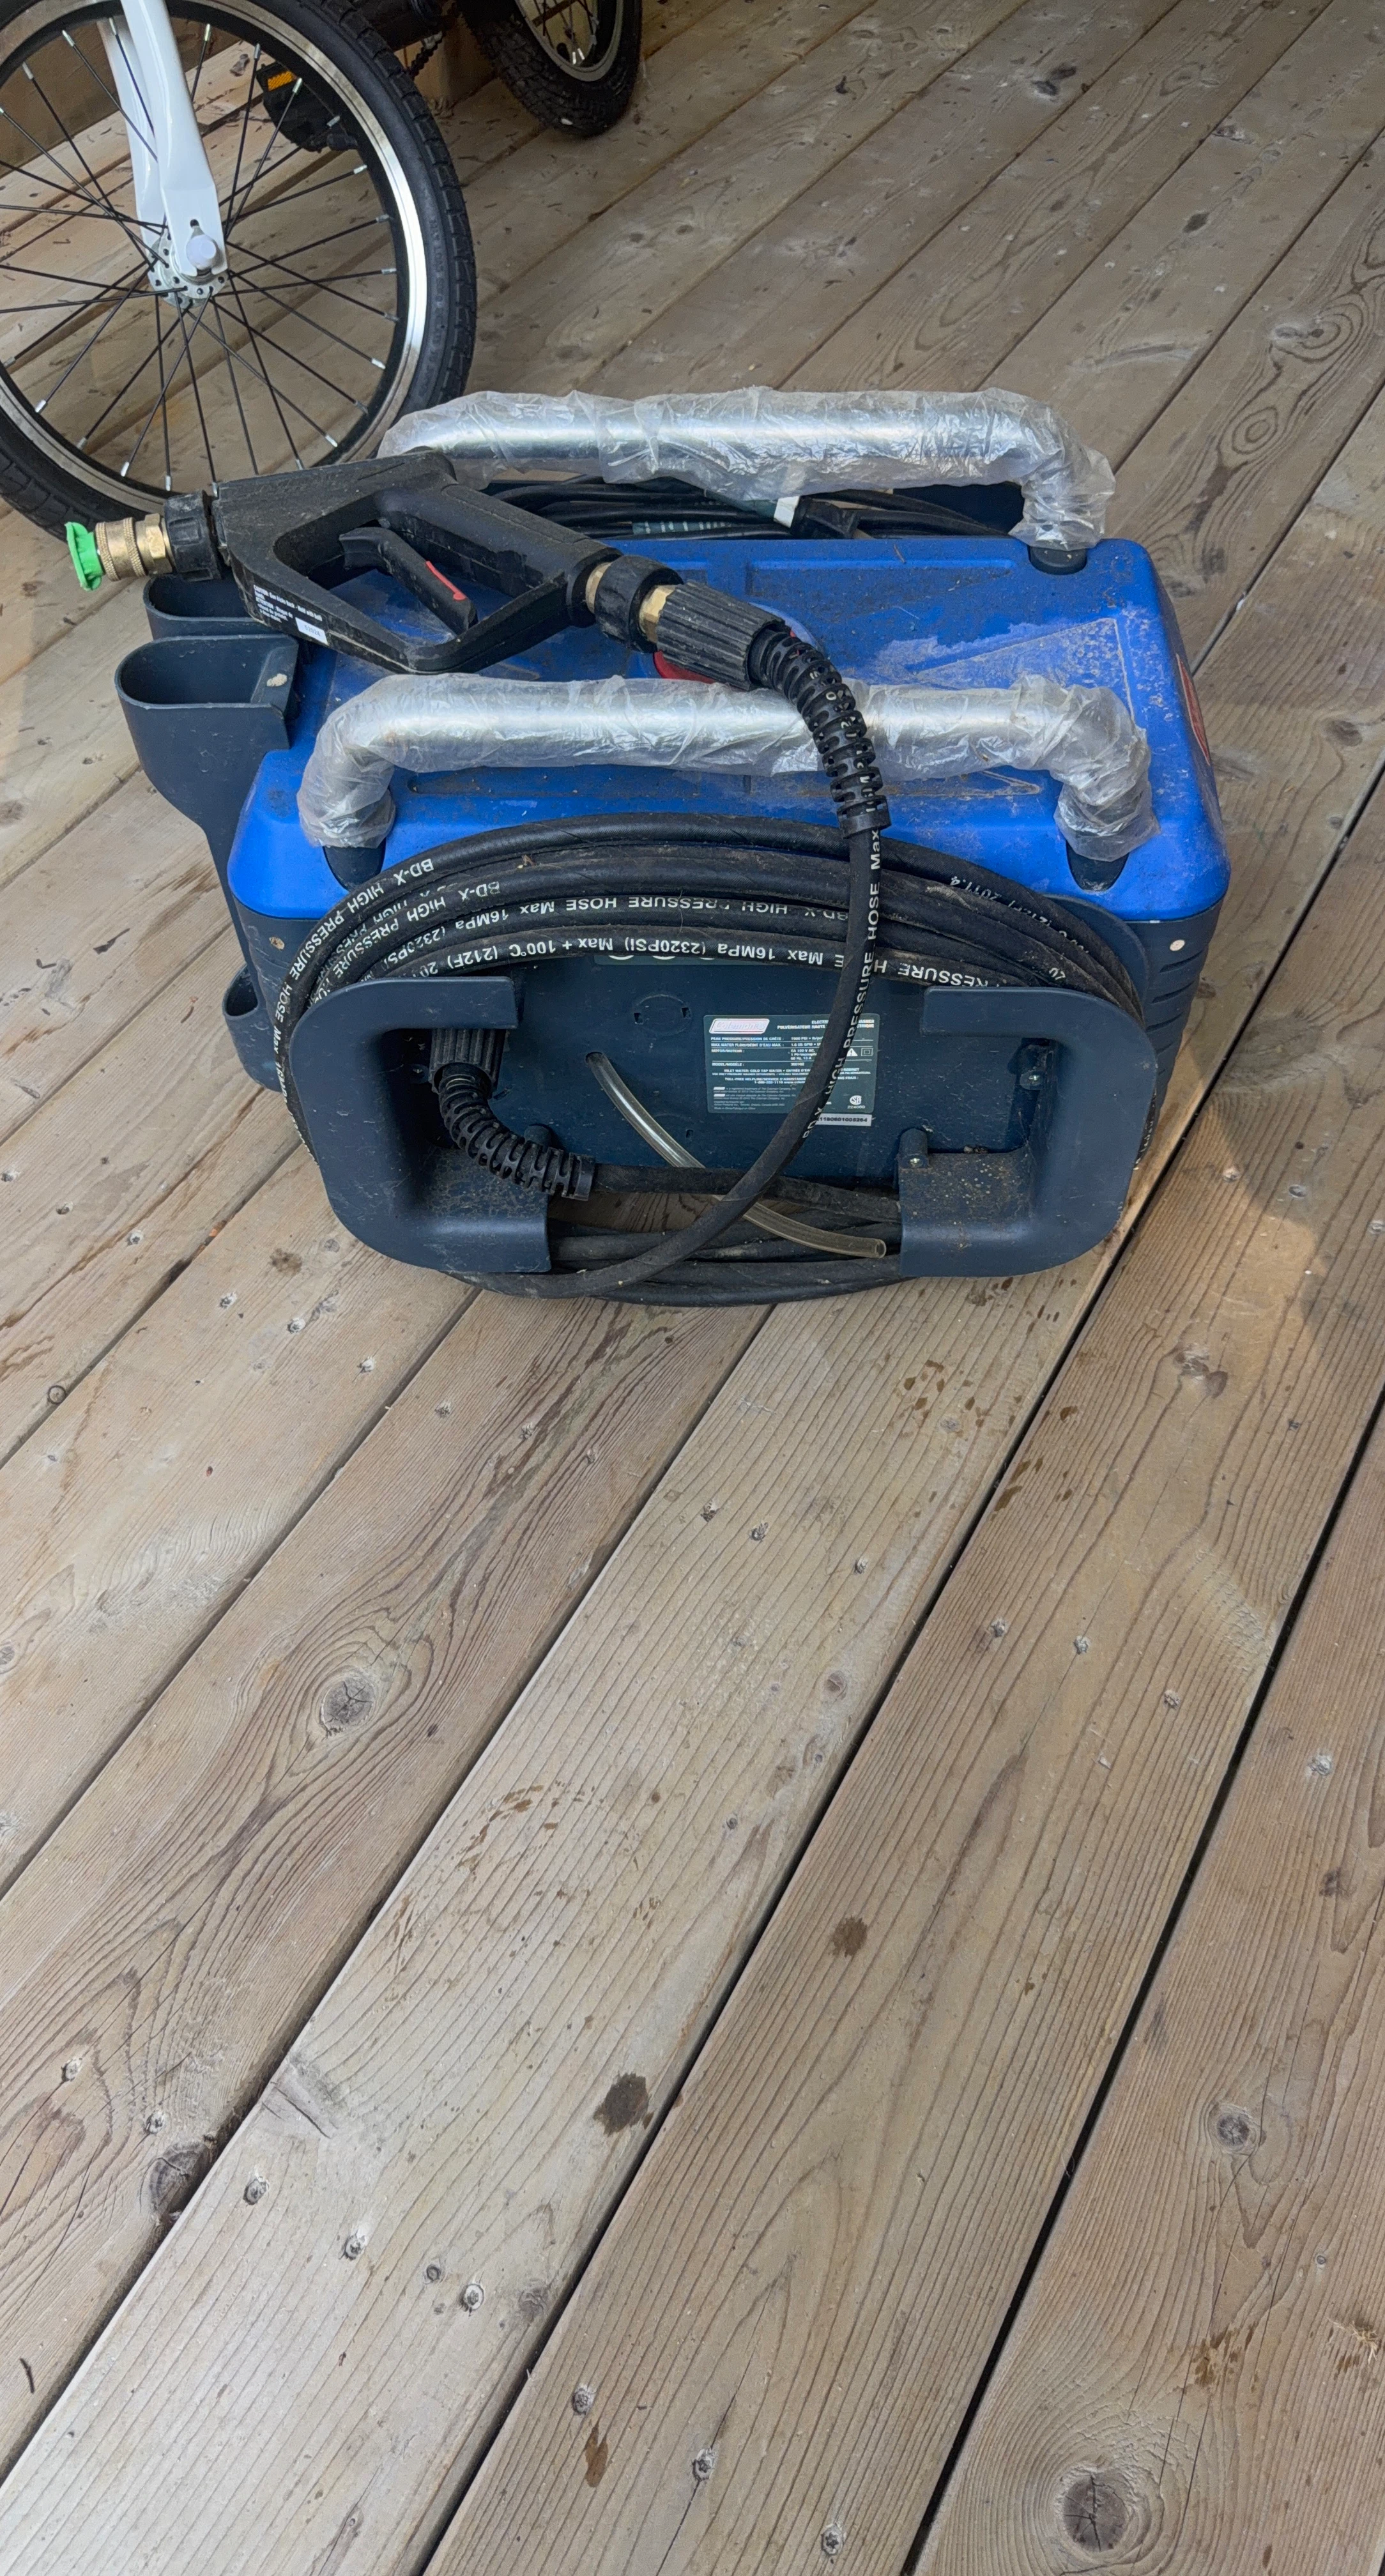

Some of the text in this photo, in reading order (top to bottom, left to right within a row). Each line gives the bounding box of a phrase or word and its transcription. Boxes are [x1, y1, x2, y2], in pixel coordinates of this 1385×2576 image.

[871, 831, 880, 870] Max
[393, 858, 434, 887] BD-X
[347, 883, 385, 914] HIGH
[457, 881, 501, 902] BD-X
[406, 896, 447, 923] HIGH
[519, 899, 555, 914] Max
[565, 896, 617, 912] HOSE
[742, 901, 788, 915] HIGH
[868, 881, 880, 940] HOSE
[455, 908, 510, 930] 16MPa
[289, 910, 345, 981] PRESSURE
[332, 917, 399, 979] PRESSURE
[562, 940, 572, 950] +
[577, 937, 613, 951] Max
[624, 937, 706, 955] (2320PSI)
[717, 943, 776, 960] 16MPa
[447, 946, 498, 969] (212F)
[787, 949, 823, 965] Max
[897, 963, 1000, 988] RESSURE
[275, 984, 293, 1023] HOSE
[845, 952, 875, 1049] PRESSURE
[716, 1022, 756, 1031] Coleman
